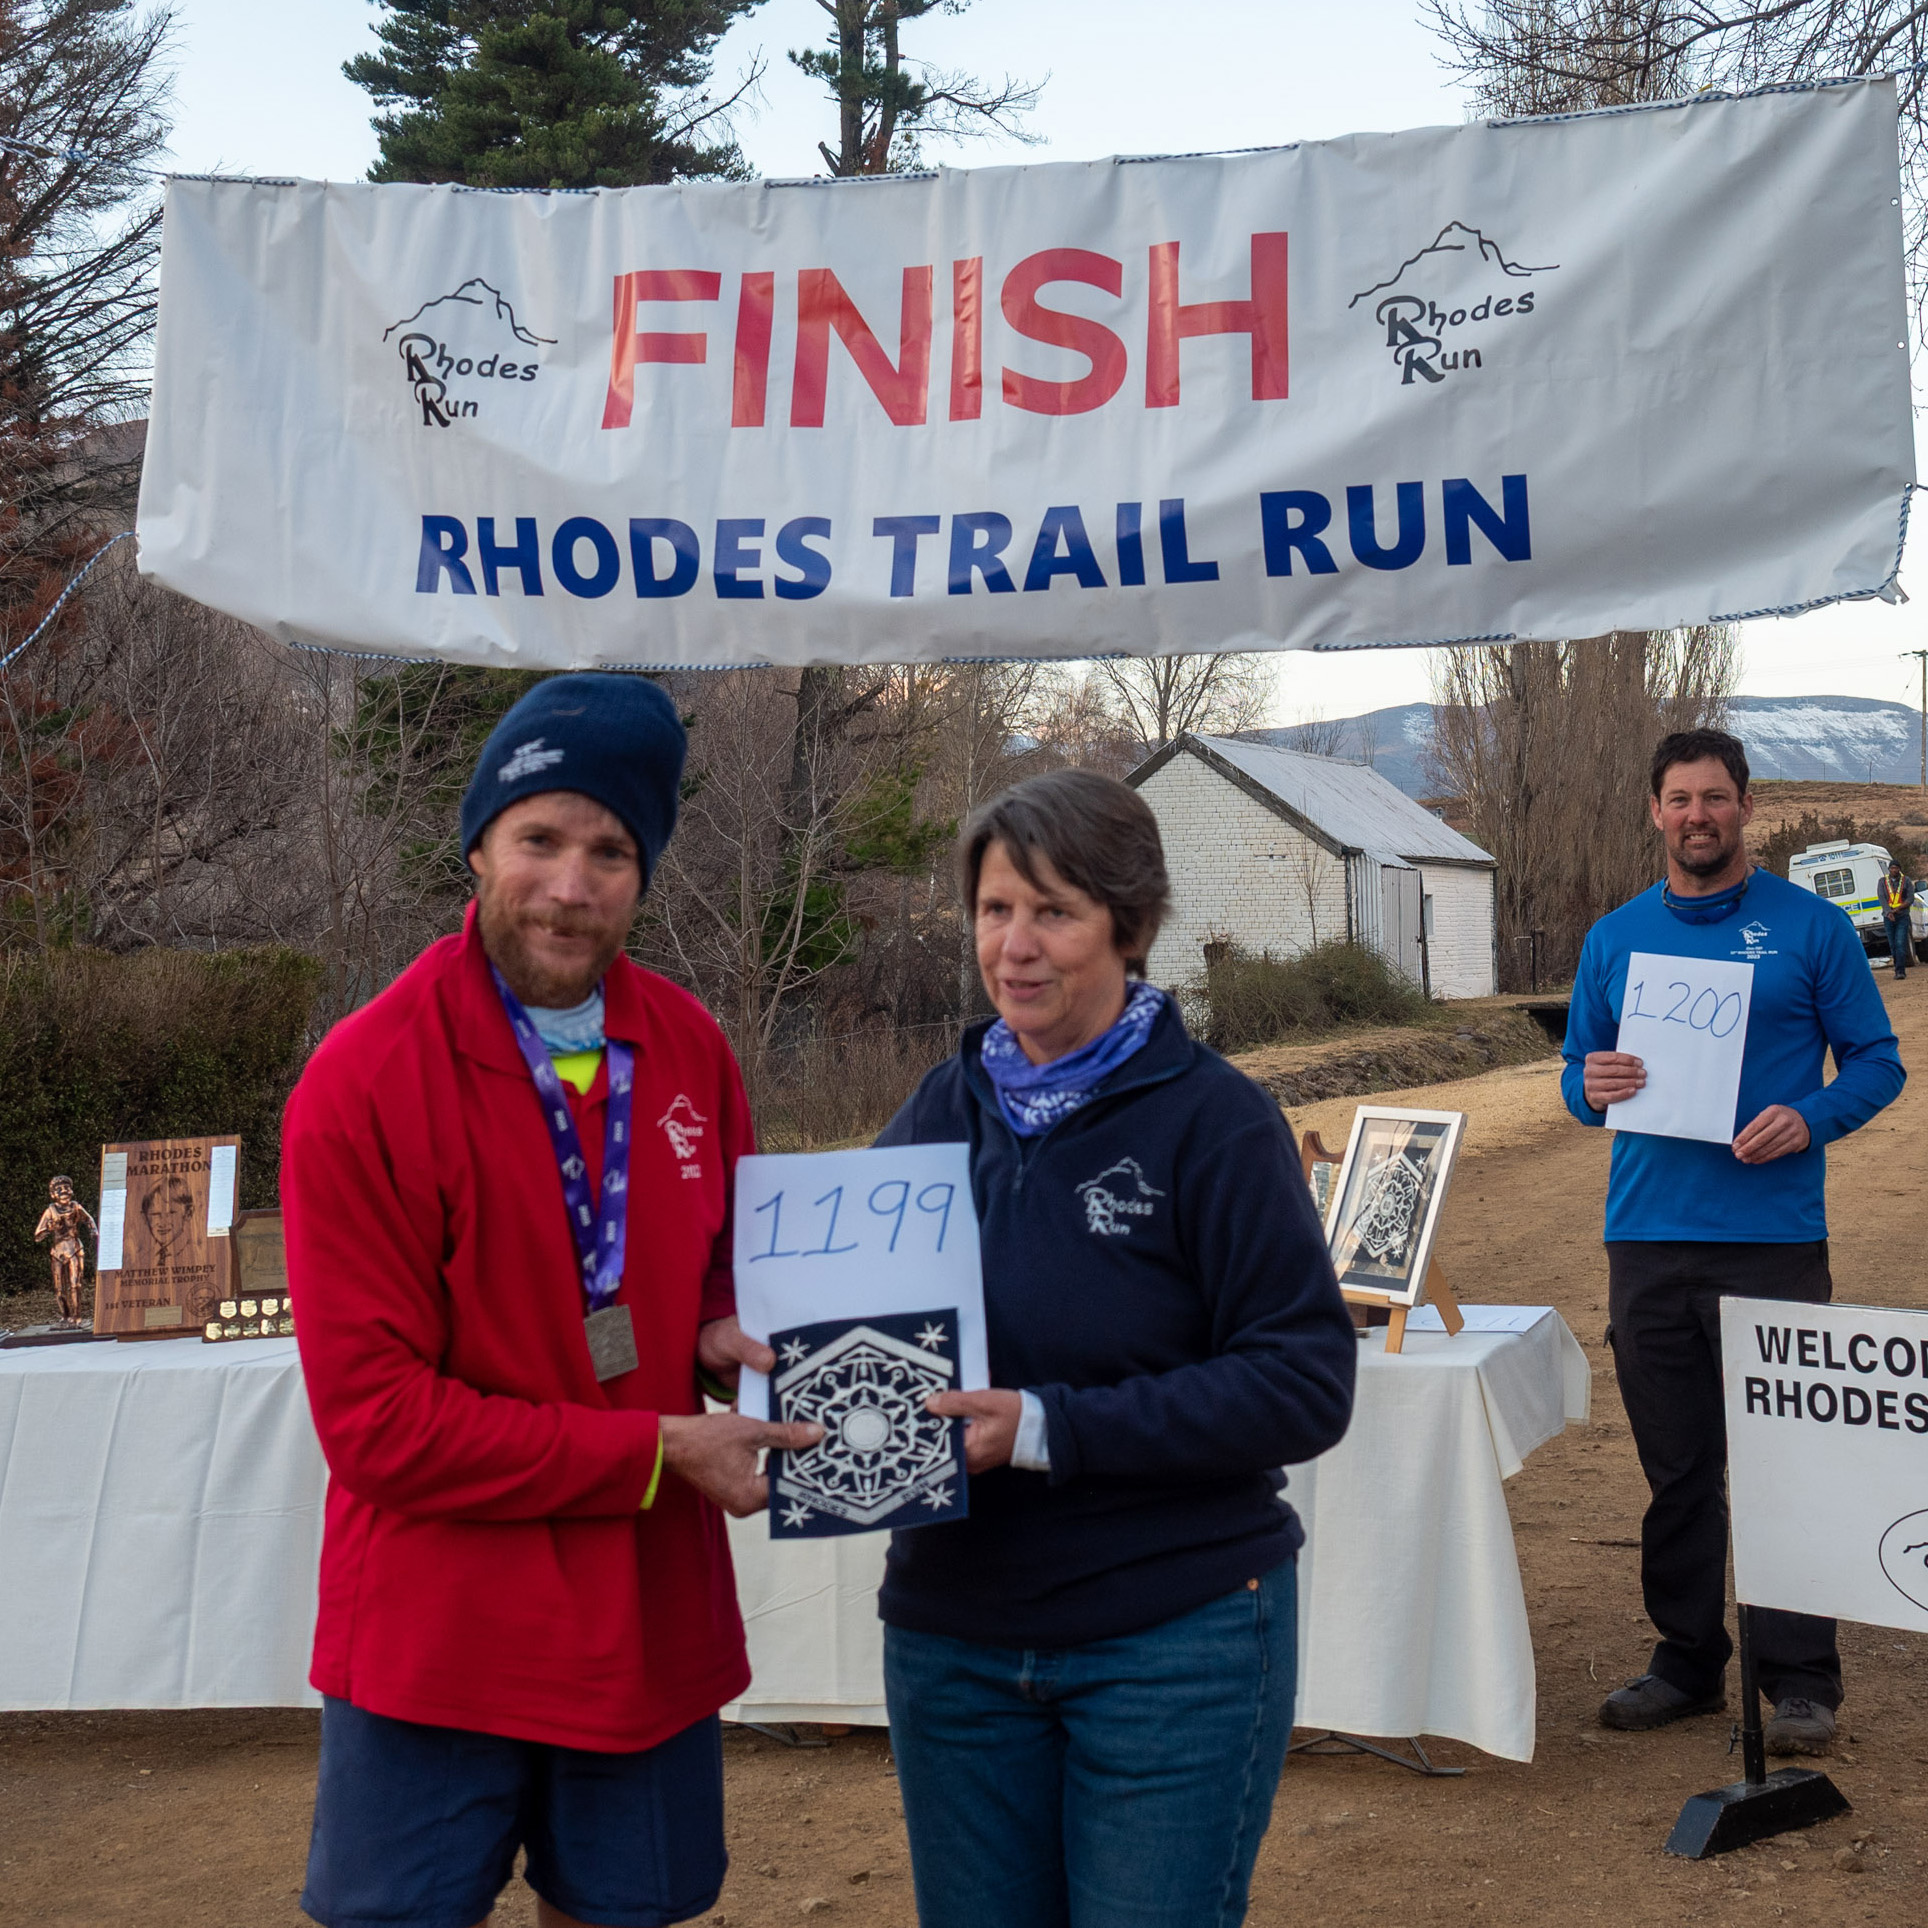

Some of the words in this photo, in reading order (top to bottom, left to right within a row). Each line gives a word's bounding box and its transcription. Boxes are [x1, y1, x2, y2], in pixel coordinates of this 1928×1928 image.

[602, 231, 1289, 430] FINISH
[1376, 291, 1536, 348] Rhodes
[398, 333, 539, 384] Rhodes
[1393, 336, 1483, 386] Run
[415, 381, 480, 429] Run
[415, 514, 832, 600] RHODES
[873, 498, 1219, 598] TRAIL
[1259, 474, 1533, 578] RUN
[1627, 980, 1742, 1038] 1200
[127, 1161, 211, 1177] MARATHON
[139, 1147, 202, 1162] RHODES
[749, 1180, 956, 1263] 1199
[1084, 1186, 1154, 1216] Rhodes
[1087, 1208, 1131, 1236] Run
[114, 1266, 169, 1278] MATTHEW
[171, 1264, 216, 1275] WIMPEY
[120, 1276, 169, 1287] MEMORIAL
[172, 1274, 210, 1284] TROPHY
[121, 1298, 171, 1309] VETERAN
[1755, 1325, 1928, 1379] WELCO
[1745, 1376, 1928, 1434] RHODES
